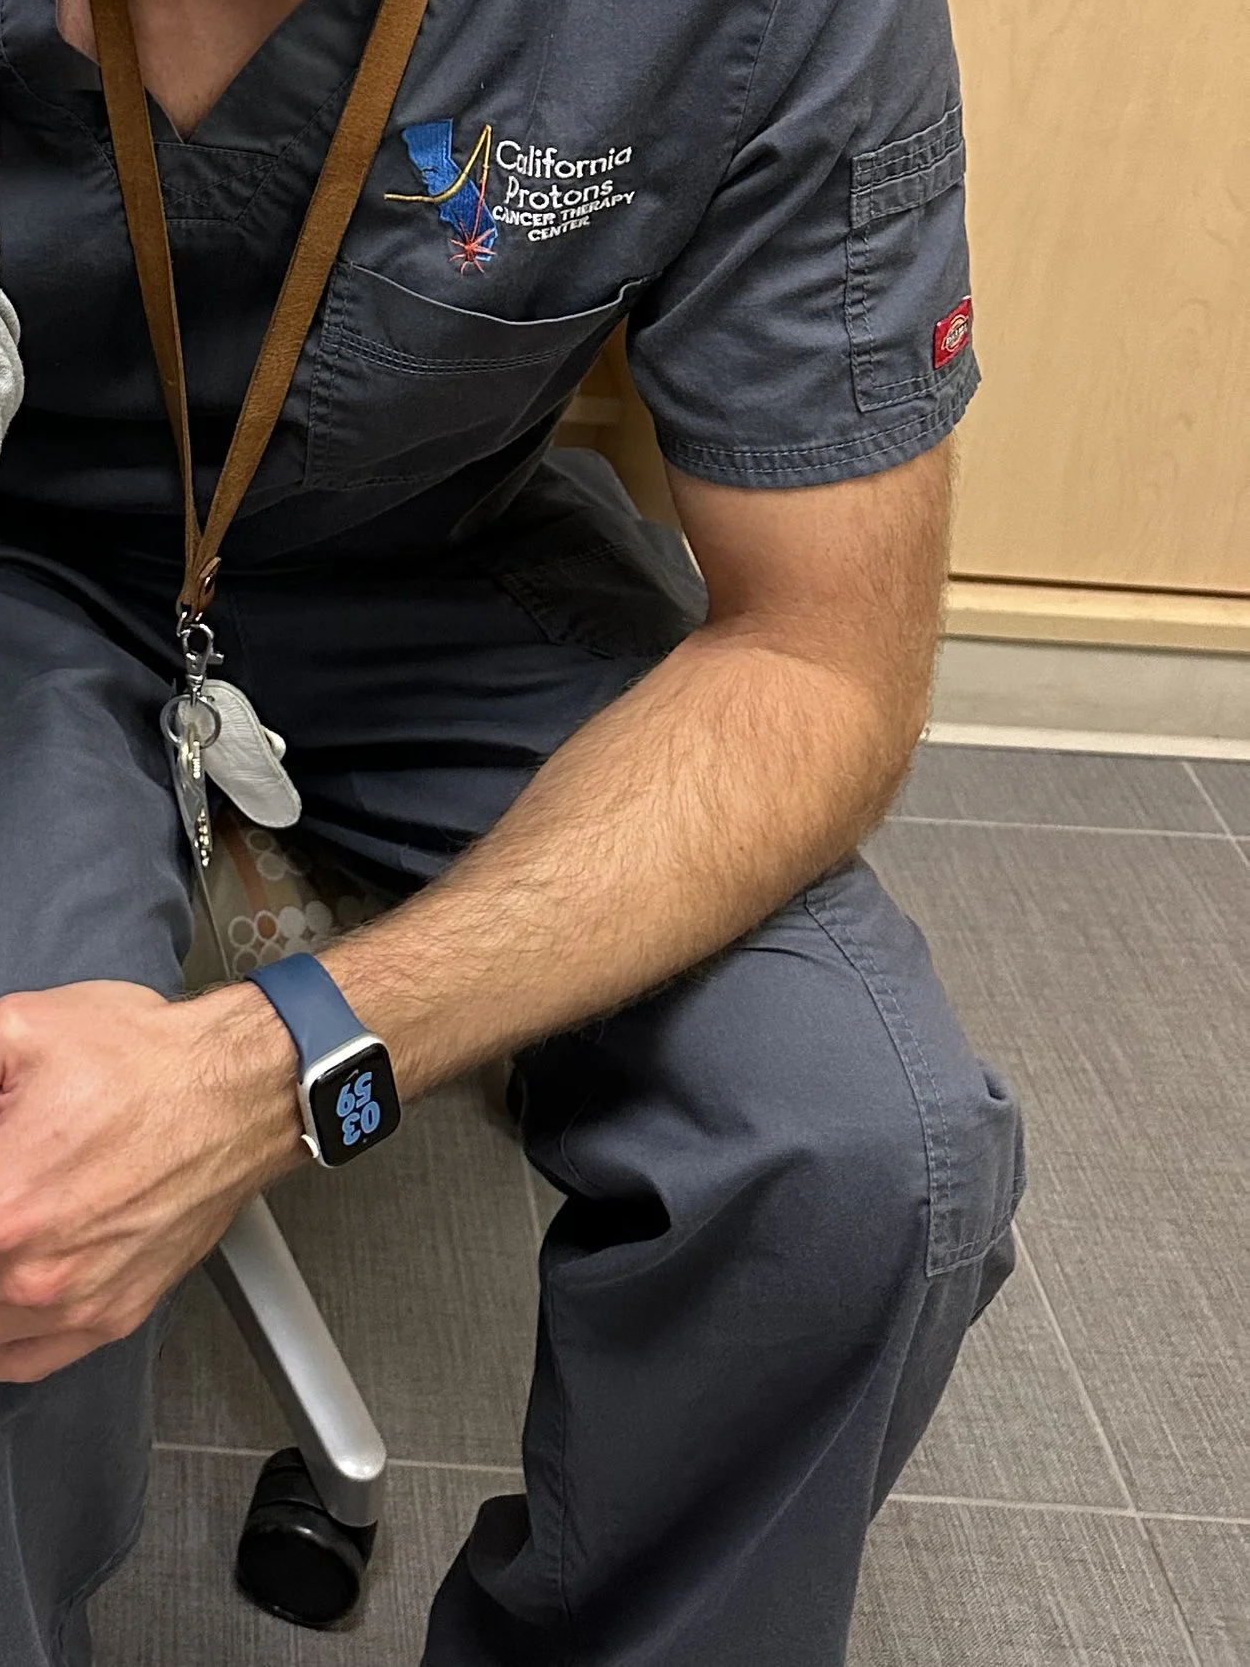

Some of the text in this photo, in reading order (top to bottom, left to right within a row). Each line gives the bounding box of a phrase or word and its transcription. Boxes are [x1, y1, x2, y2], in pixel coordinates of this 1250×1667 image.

[495, 140, 633, 179] California
[492, 190, 636, 227] CANCER THERAPY
[503, 175, 614, 210] Protons
[527, 214, 592, 243] CENTER
